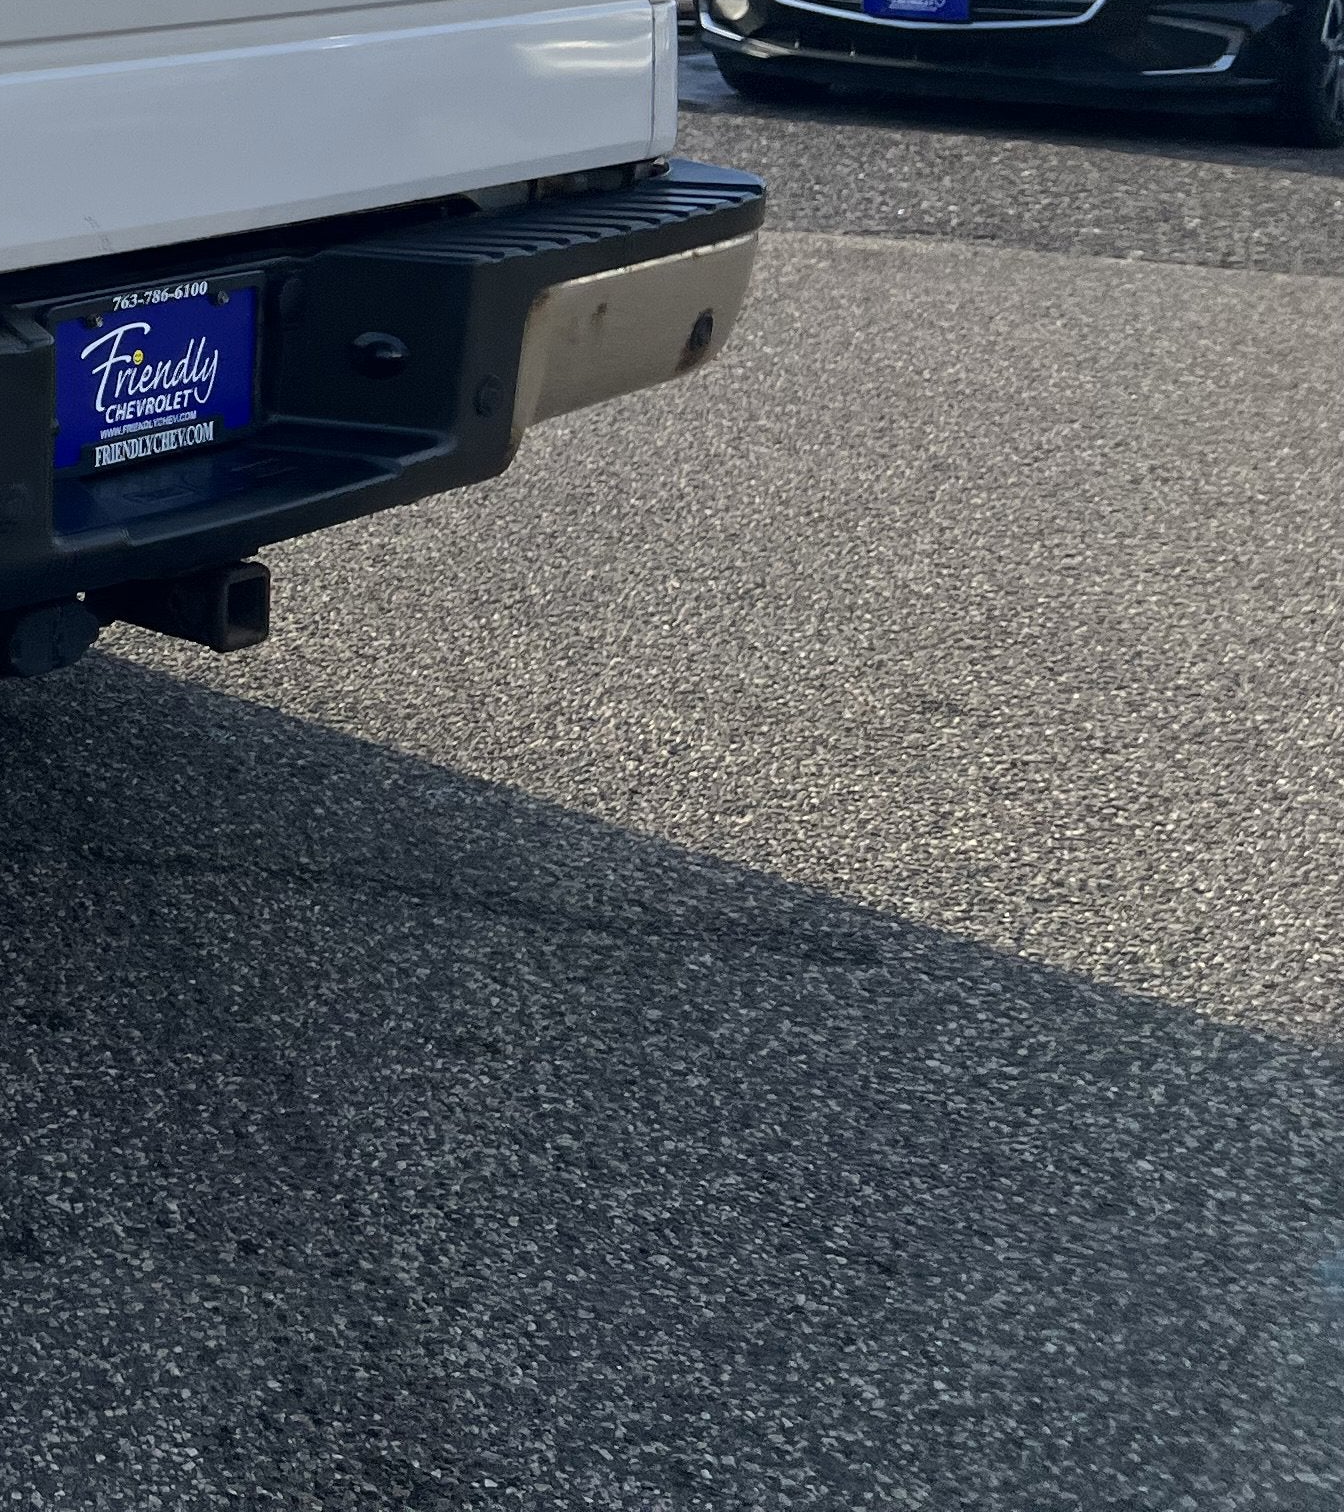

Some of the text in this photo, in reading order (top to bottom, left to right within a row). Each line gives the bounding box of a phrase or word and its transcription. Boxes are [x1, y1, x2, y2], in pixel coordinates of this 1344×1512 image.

[113, 281, 208, 311] 763-786-6100
[80, 321, 219, 412] Friendly
[105, 389, 194, 424] CHEVROLET
[94, 420, 215, 468] FRIENDLYCHEV.COM
